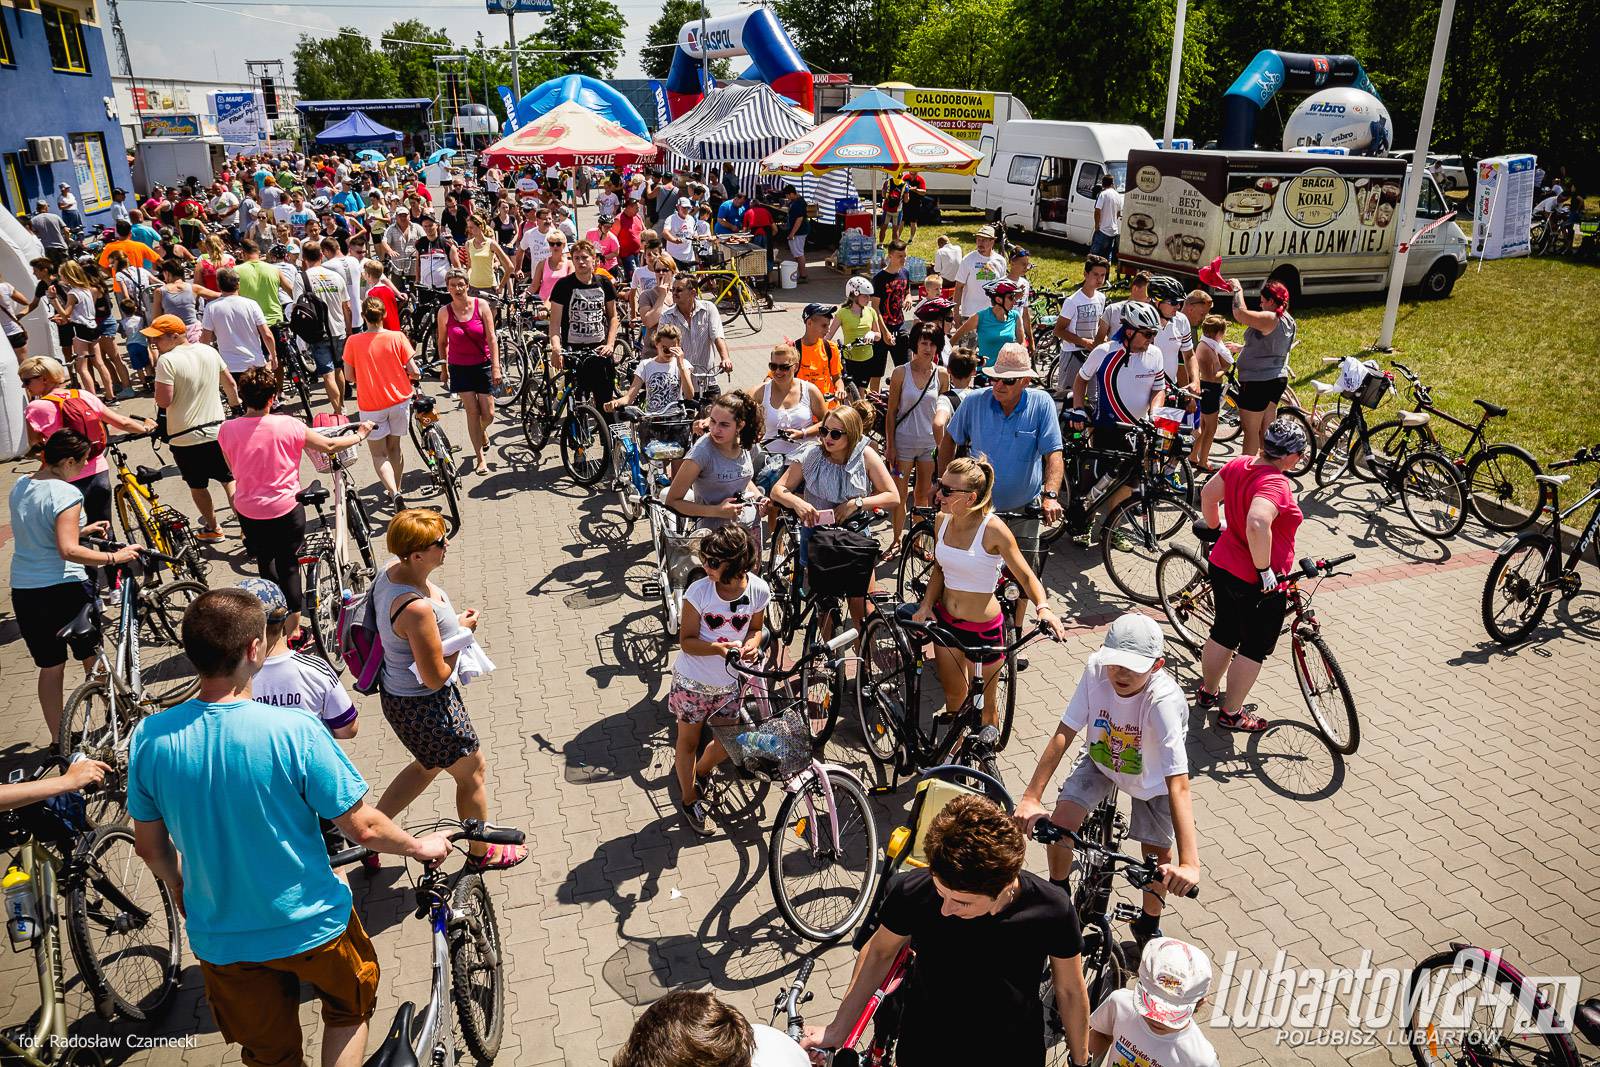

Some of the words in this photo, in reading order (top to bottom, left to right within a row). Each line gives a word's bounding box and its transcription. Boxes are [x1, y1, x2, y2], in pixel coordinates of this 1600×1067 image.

[916, 93, 982, 106] CAŁODOBOWA
[943, 107, 991, 119] DROGOWA
[1310, 102, 1346, 113] wibro
[506, 154, 547, 166] TYSKIE
[573, 153, 616, 165] TYSKIE
[1302, 178, 1335, 188] BRACIA
[1179, 197, 1202, 209] BEST
[1297, 192, 1334, 207] KORAL
[1171, 206, 1208, 218] LUBARTÓW
[1278, 231, 1311, 254] JAK
[252, 692, 302, 706] ONALDO
